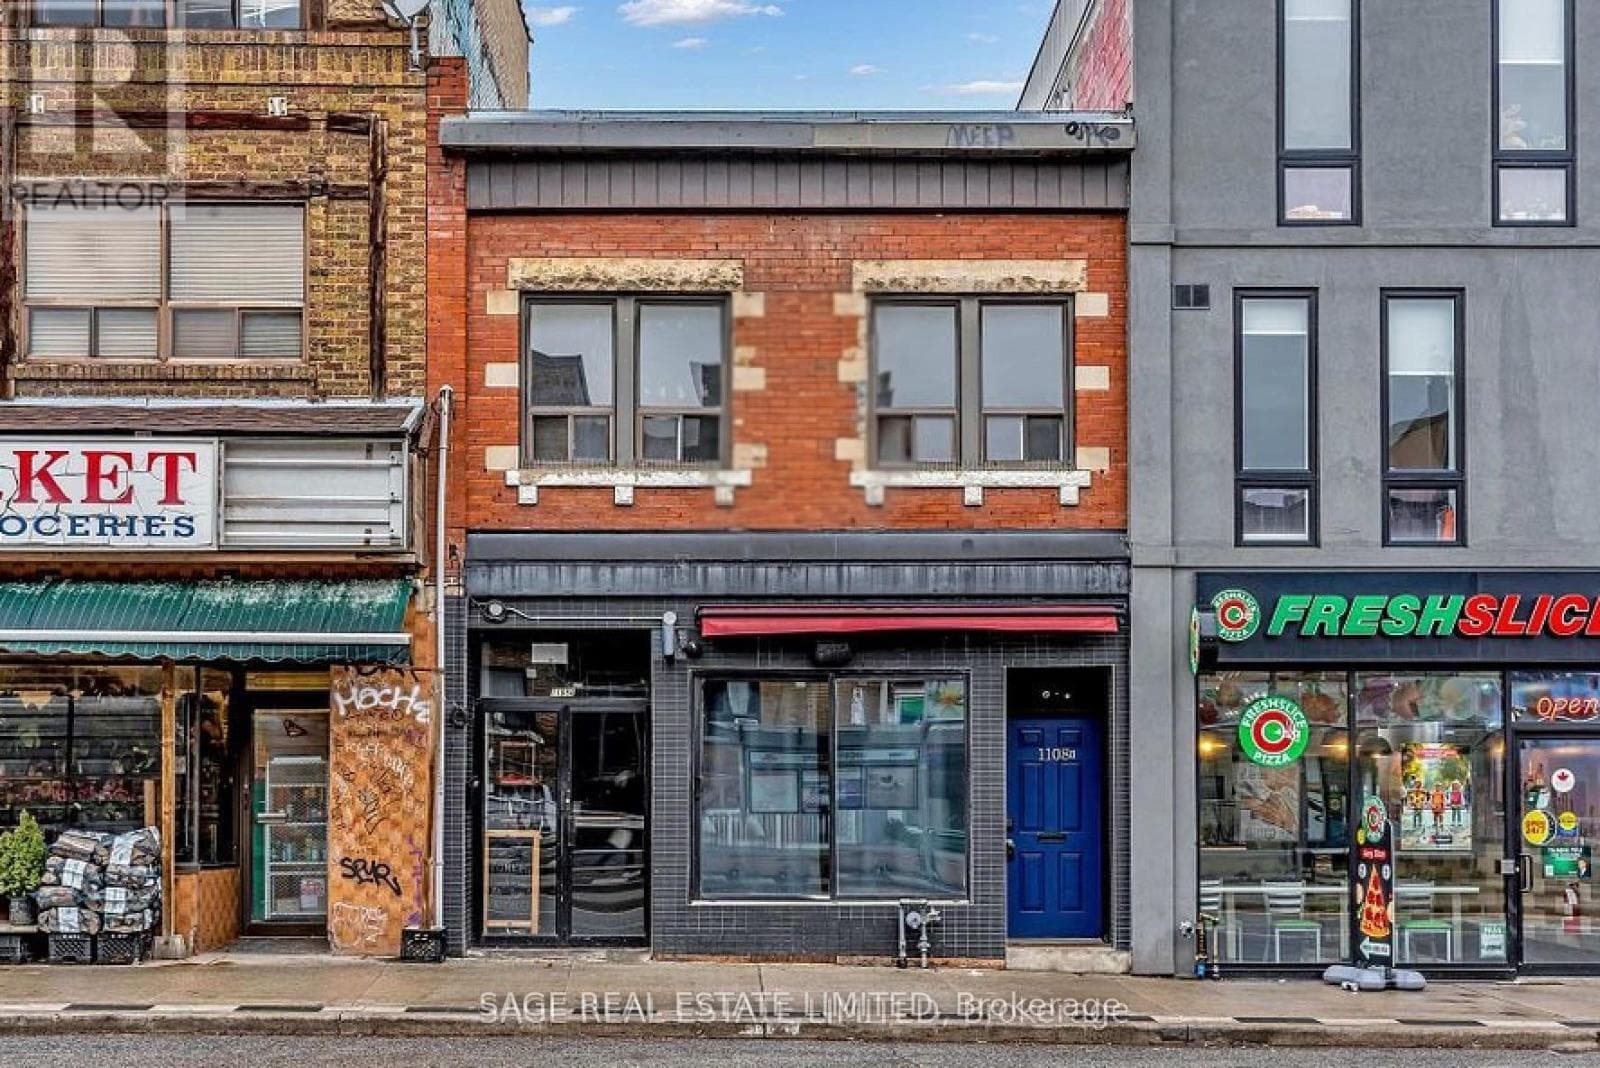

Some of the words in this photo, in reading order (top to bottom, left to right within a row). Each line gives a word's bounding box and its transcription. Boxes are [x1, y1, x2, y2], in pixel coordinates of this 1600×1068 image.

[0, 451, 196, 506] KET
[1242, 698, 1308, 729] FRESHSLICE
[1253, 751, 1290, 766] PIZZA
